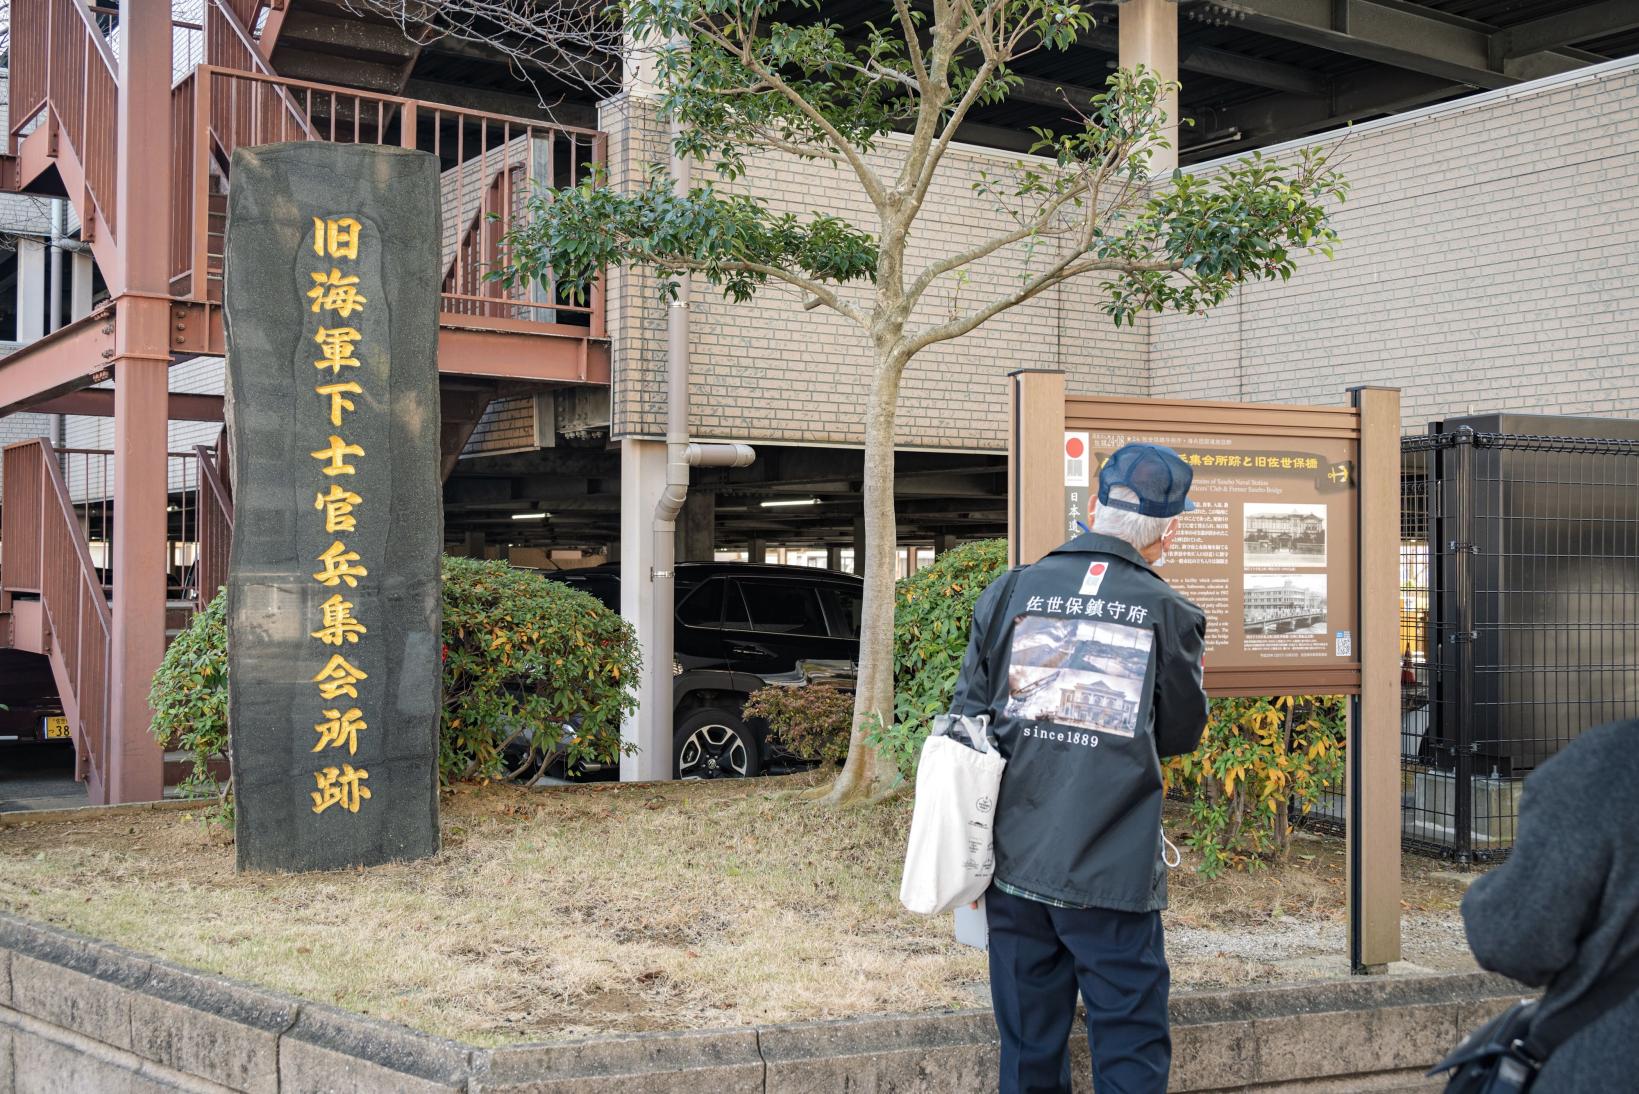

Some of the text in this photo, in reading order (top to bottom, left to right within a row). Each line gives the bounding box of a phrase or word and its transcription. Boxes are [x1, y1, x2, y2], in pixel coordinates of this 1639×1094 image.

[308, 216, 372, 815] 旧海軍下士官兵集会所跡
[1025, 595, 1149, 624] 佐世保鎮守府
